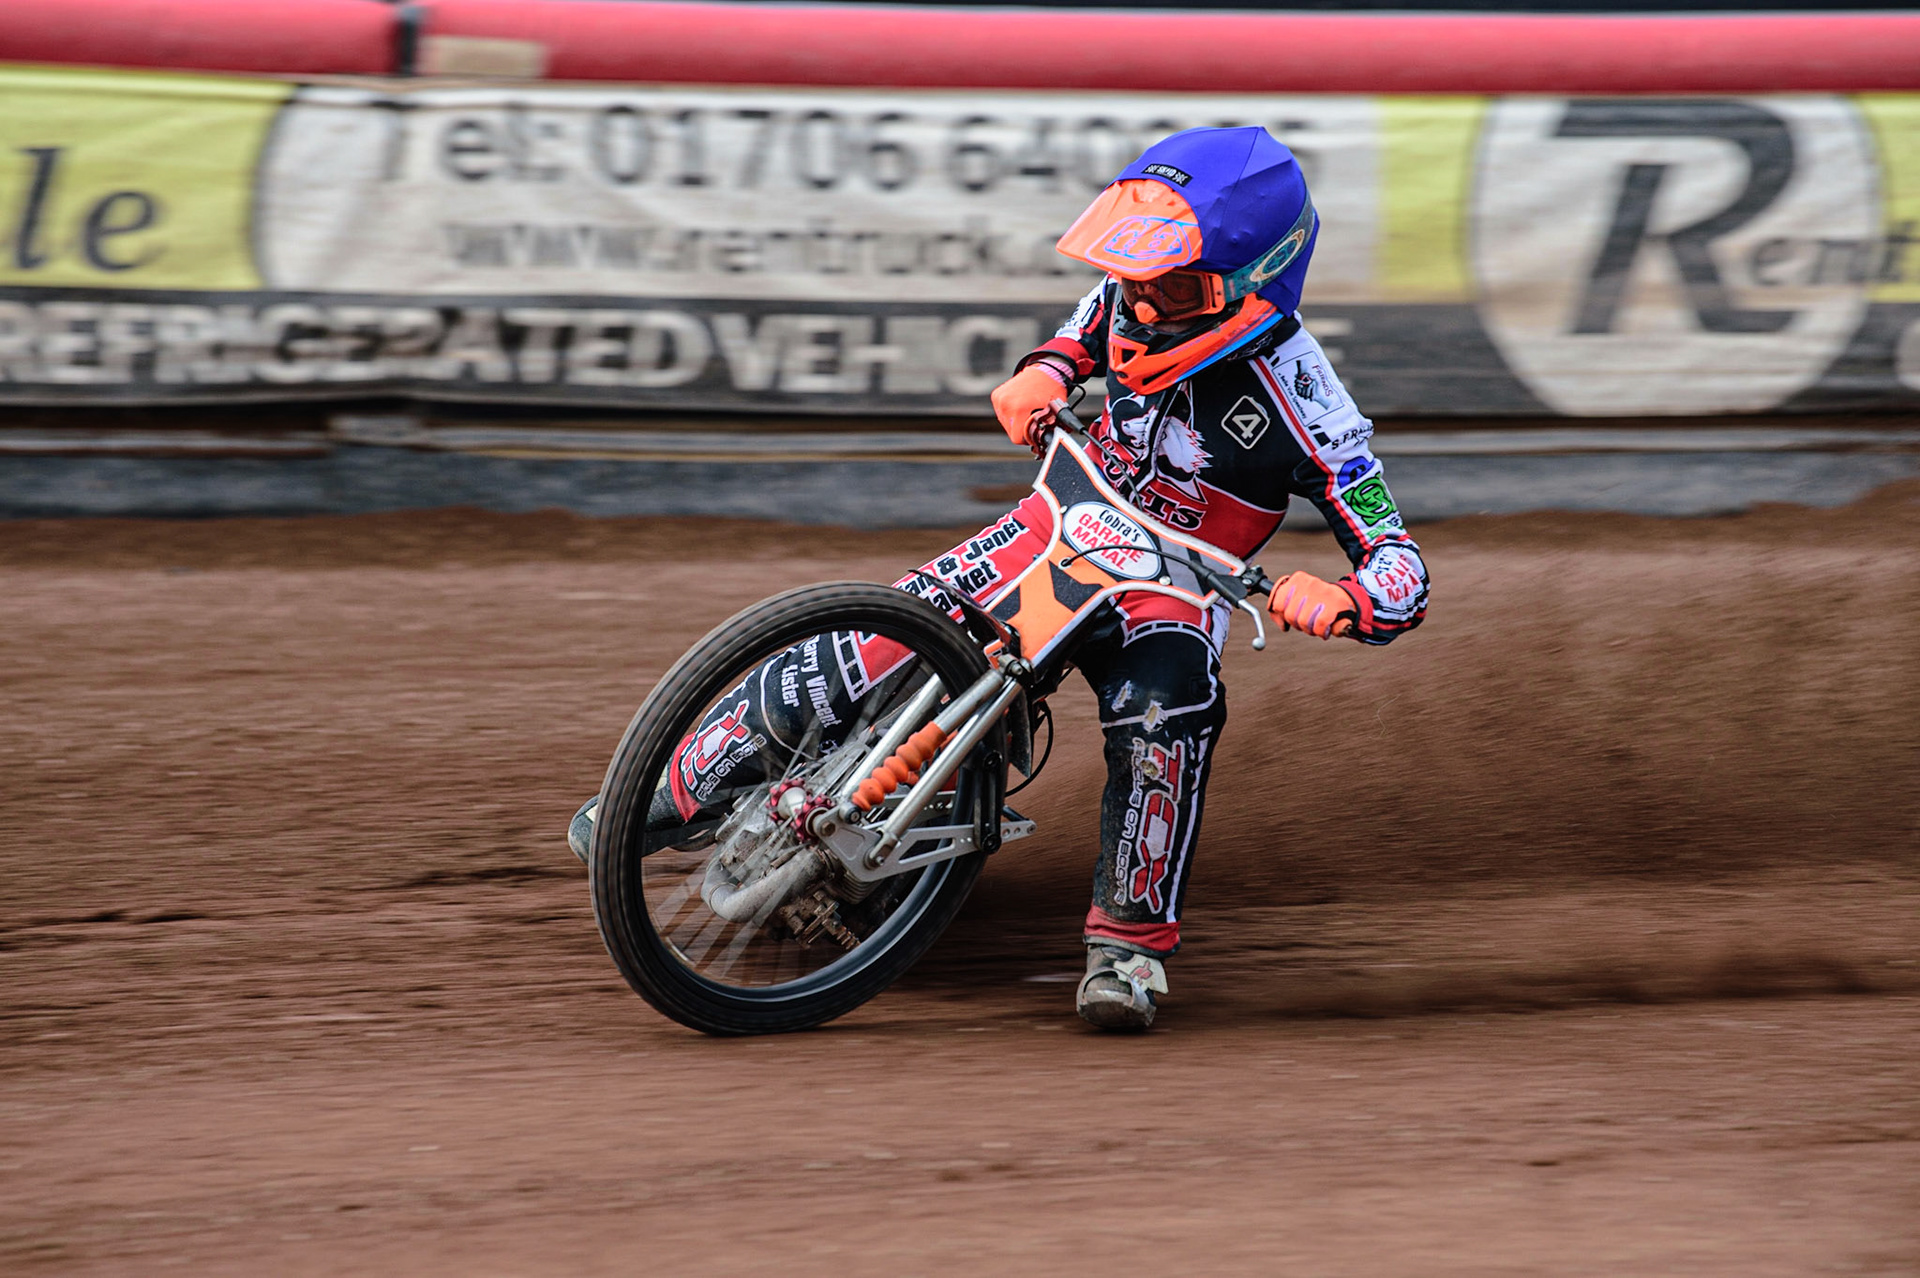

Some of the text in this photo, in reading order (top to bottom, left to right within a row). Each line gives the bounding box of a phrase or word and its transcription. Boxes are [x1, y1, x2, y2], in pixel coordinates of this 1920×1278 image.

[1231, 413, 1262, 440] 4
[1078, 513, 1145, 563] GARAGE
[1098, 509, 1142, 543] Cobra's
[926, 560, 999, 613] aket
[805, 674, 842, 729] Vincent
[1113, 839, 1133, 907] BOOTS
